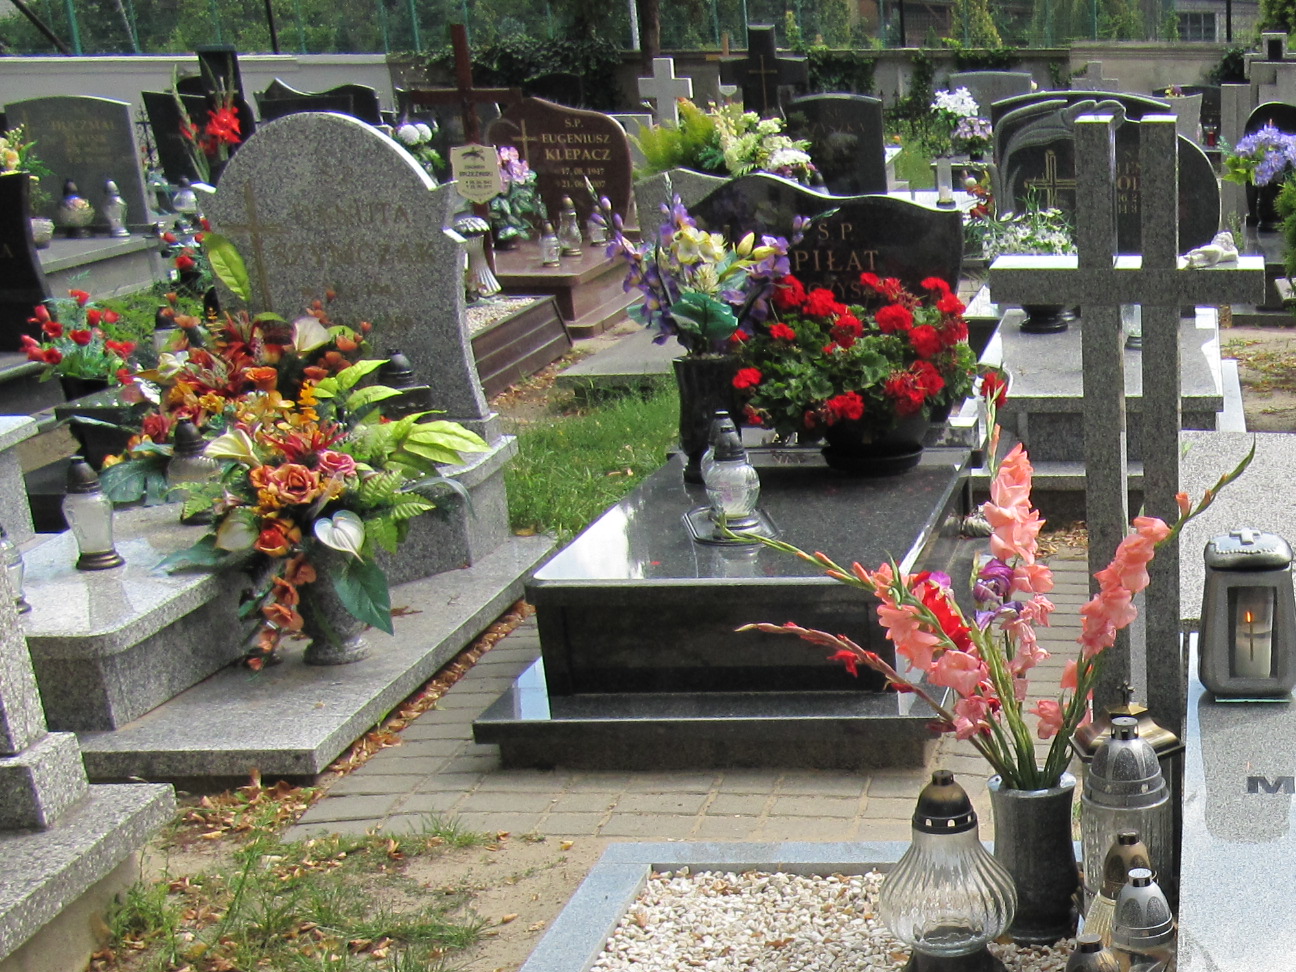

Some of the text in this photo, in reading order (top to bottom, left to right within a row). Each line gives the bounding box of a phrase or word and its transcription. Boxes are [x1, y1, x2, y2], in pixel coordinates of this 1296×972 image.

[541, 133, 611, 143] EUGENIUSZ
[545, 148, 611, 160] KLEPACZ
[794, 250, 879, 271] PIŁAT
